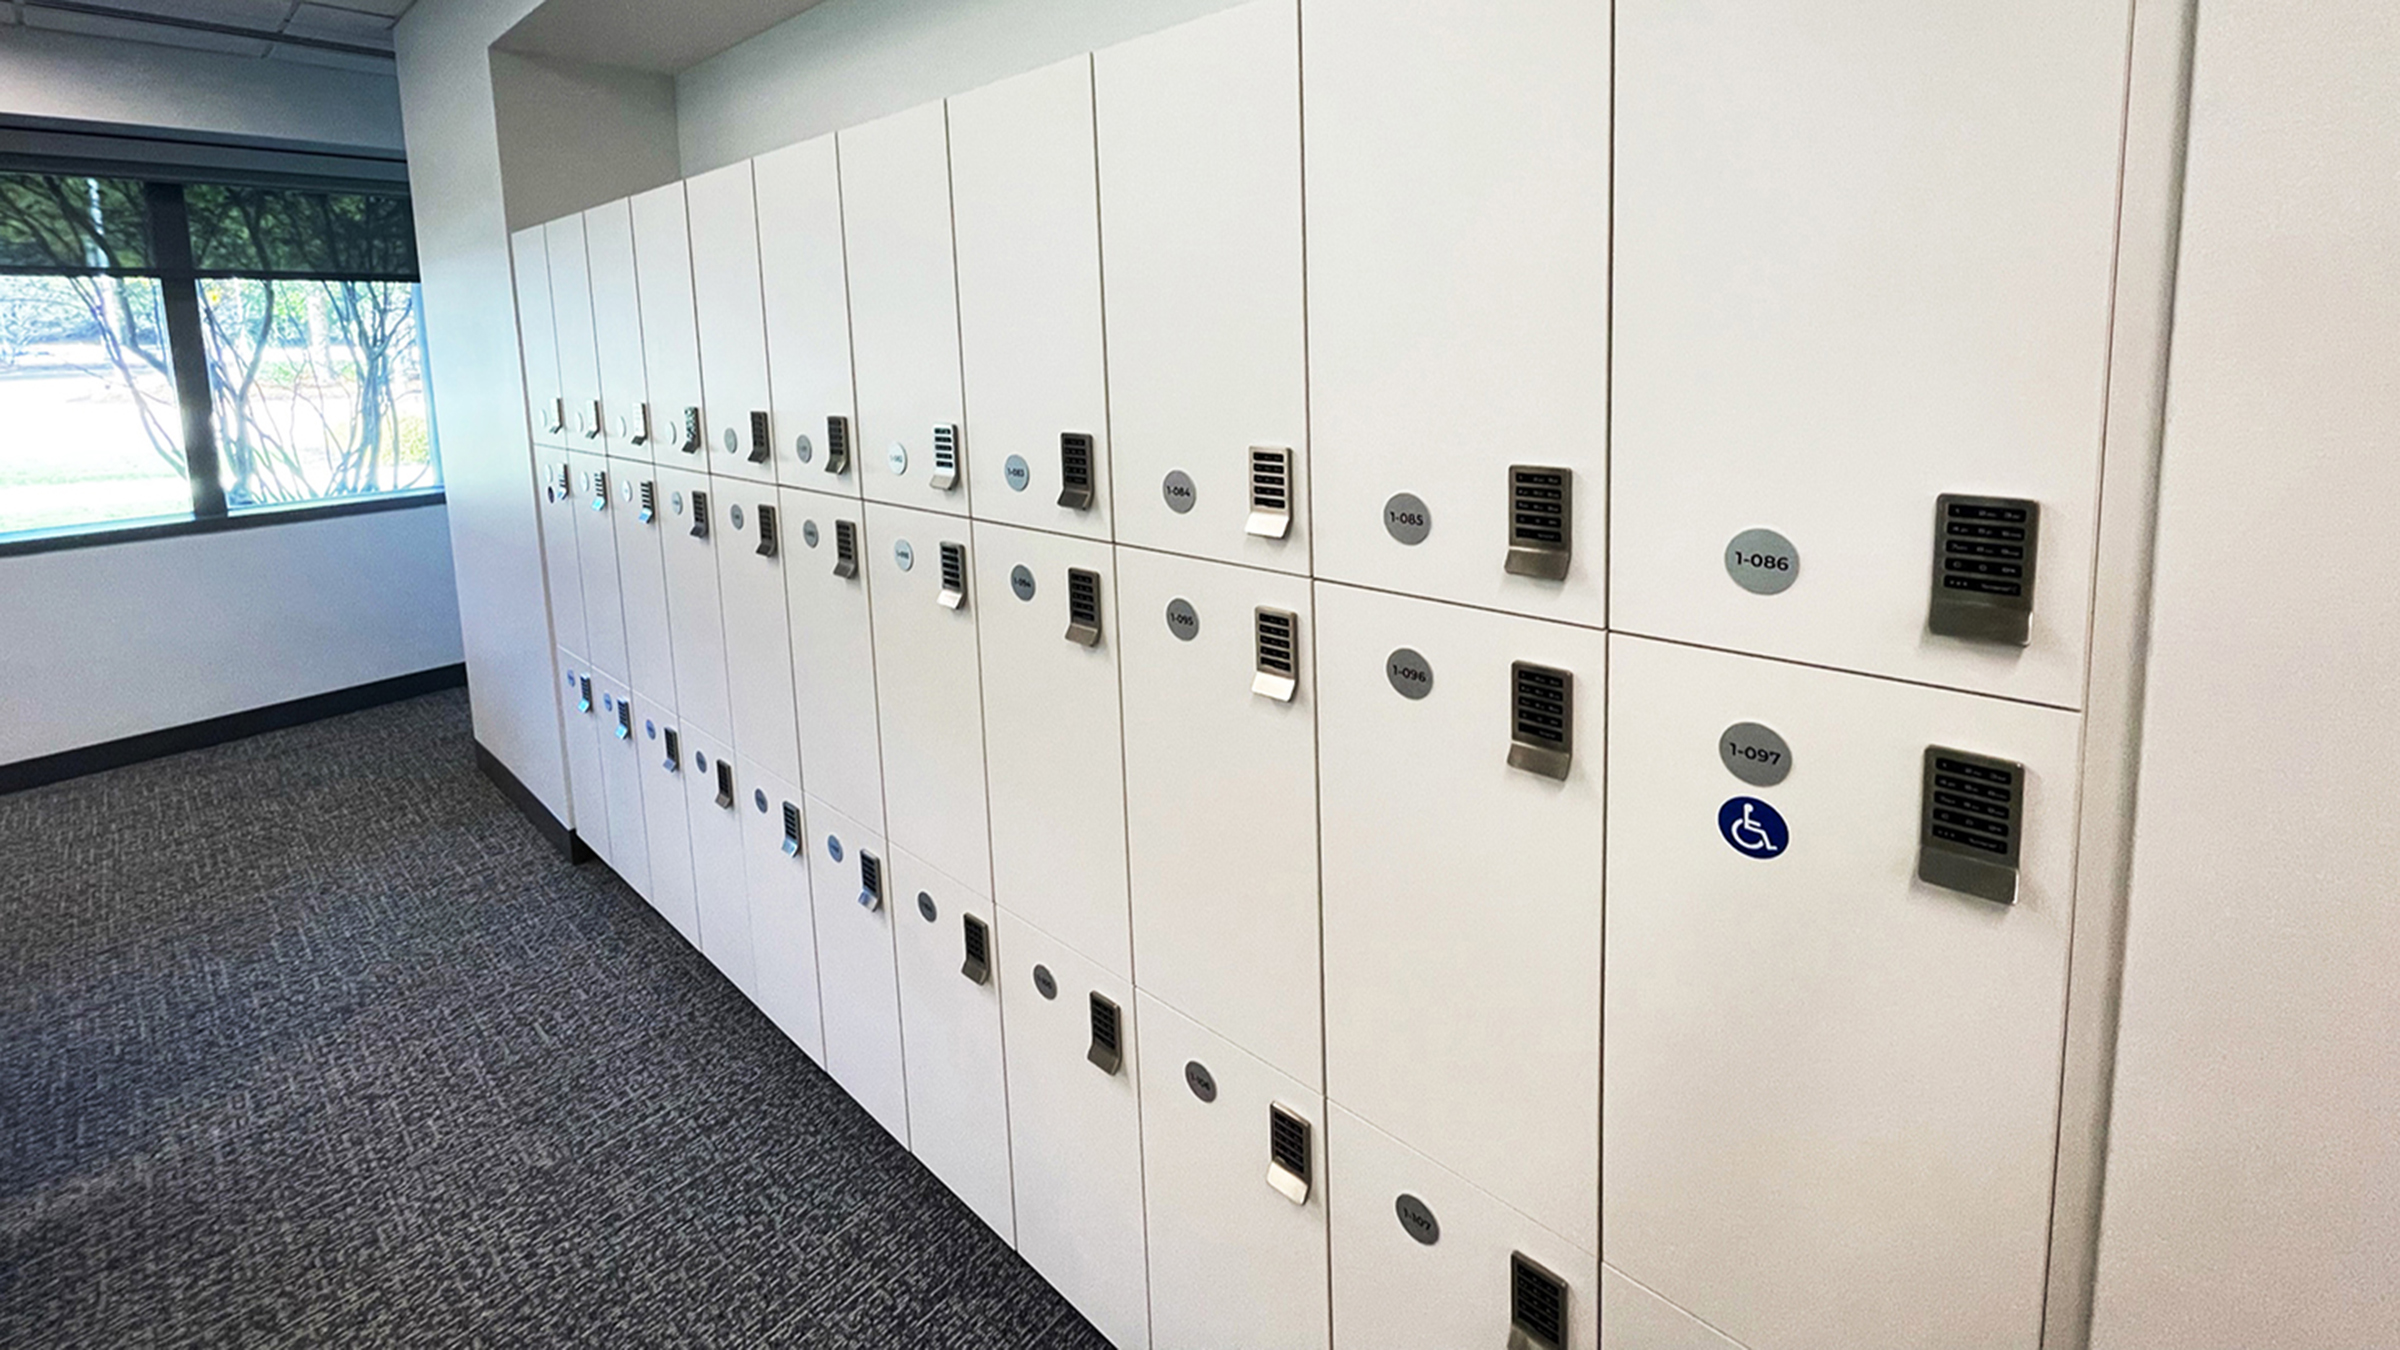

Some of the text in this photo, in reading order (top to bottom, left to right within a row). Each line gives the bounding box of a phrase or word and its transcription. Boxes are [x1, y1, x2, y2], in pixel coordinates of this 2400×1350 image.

[1166, 485, 1190, 497] 1-084
[1389, 511, 1423, 526] 1-085
[1735, 551, 1789, 571] 1-086
[1170, 612, 1194, 626] 1-095
[1392, 665, 1426, 683] 1-096
[1729, 742, 1781, 765] 1-097
[1403, 1207, 1431, 1231] 1-107
